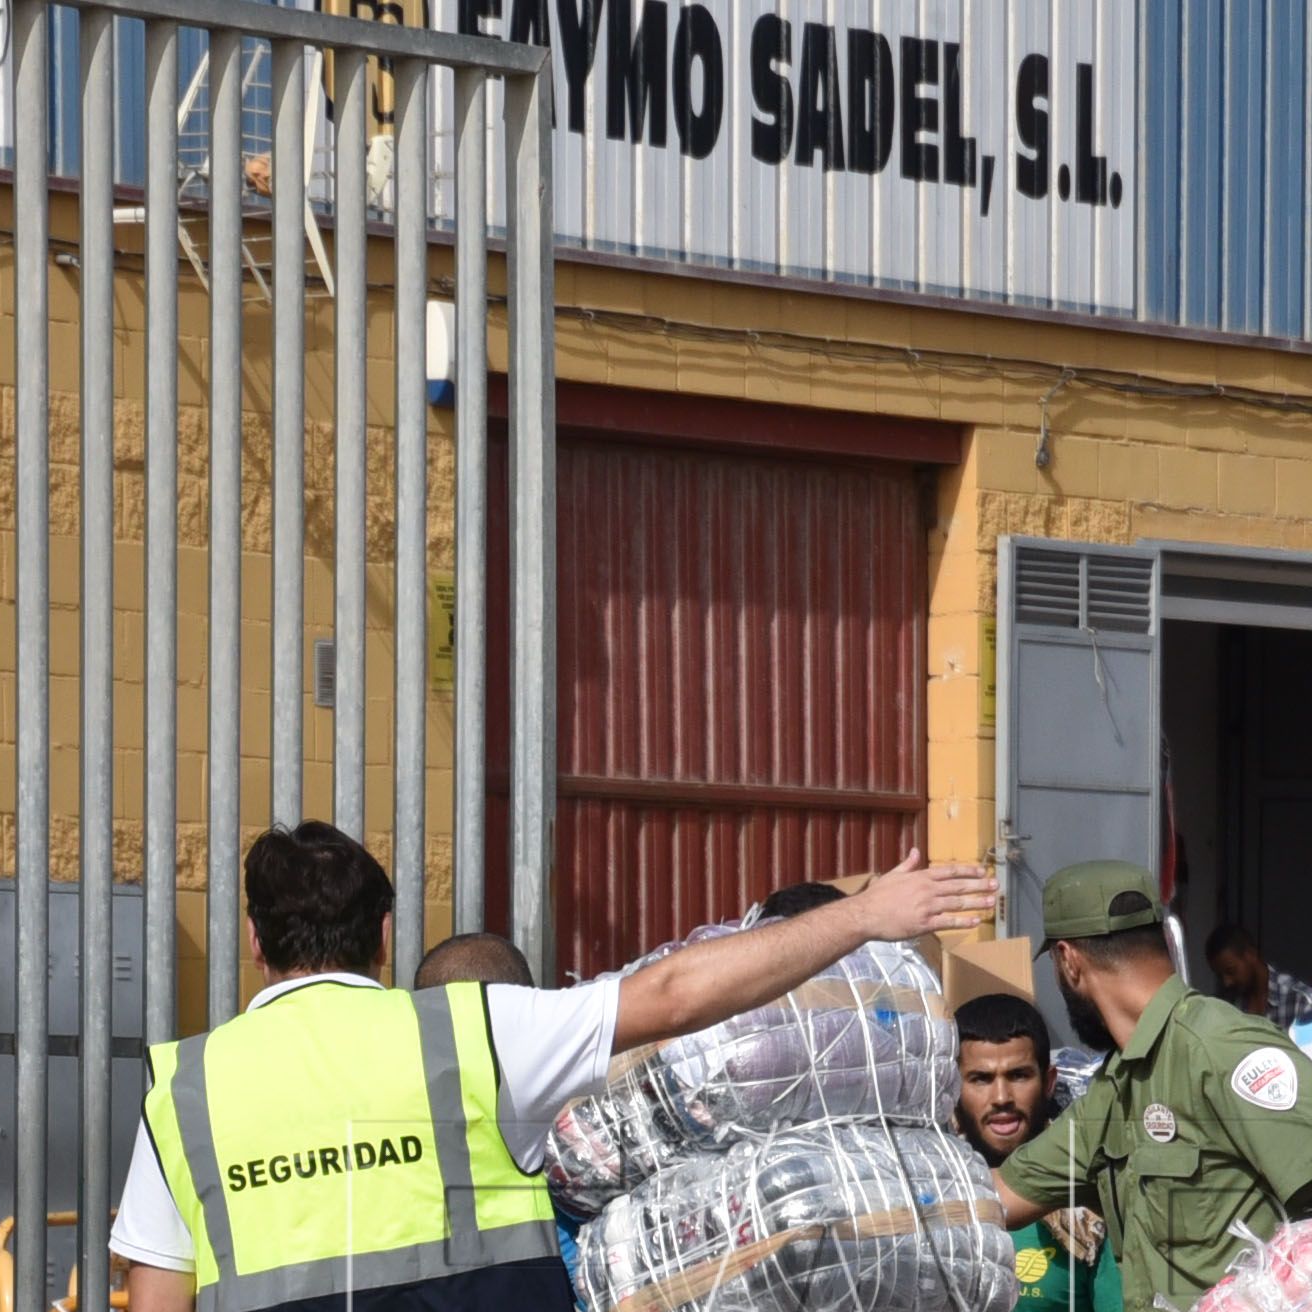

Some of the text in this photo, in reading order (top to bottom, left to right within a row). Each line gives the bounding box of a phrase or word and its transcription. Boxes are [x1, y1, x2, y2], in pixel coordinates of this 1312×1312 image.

[749, 10, 997, 217] SADEL,
[1015, 53, 1124, 210] S.L.
[227, 1134, 423, 1192] SEGURIDAD
